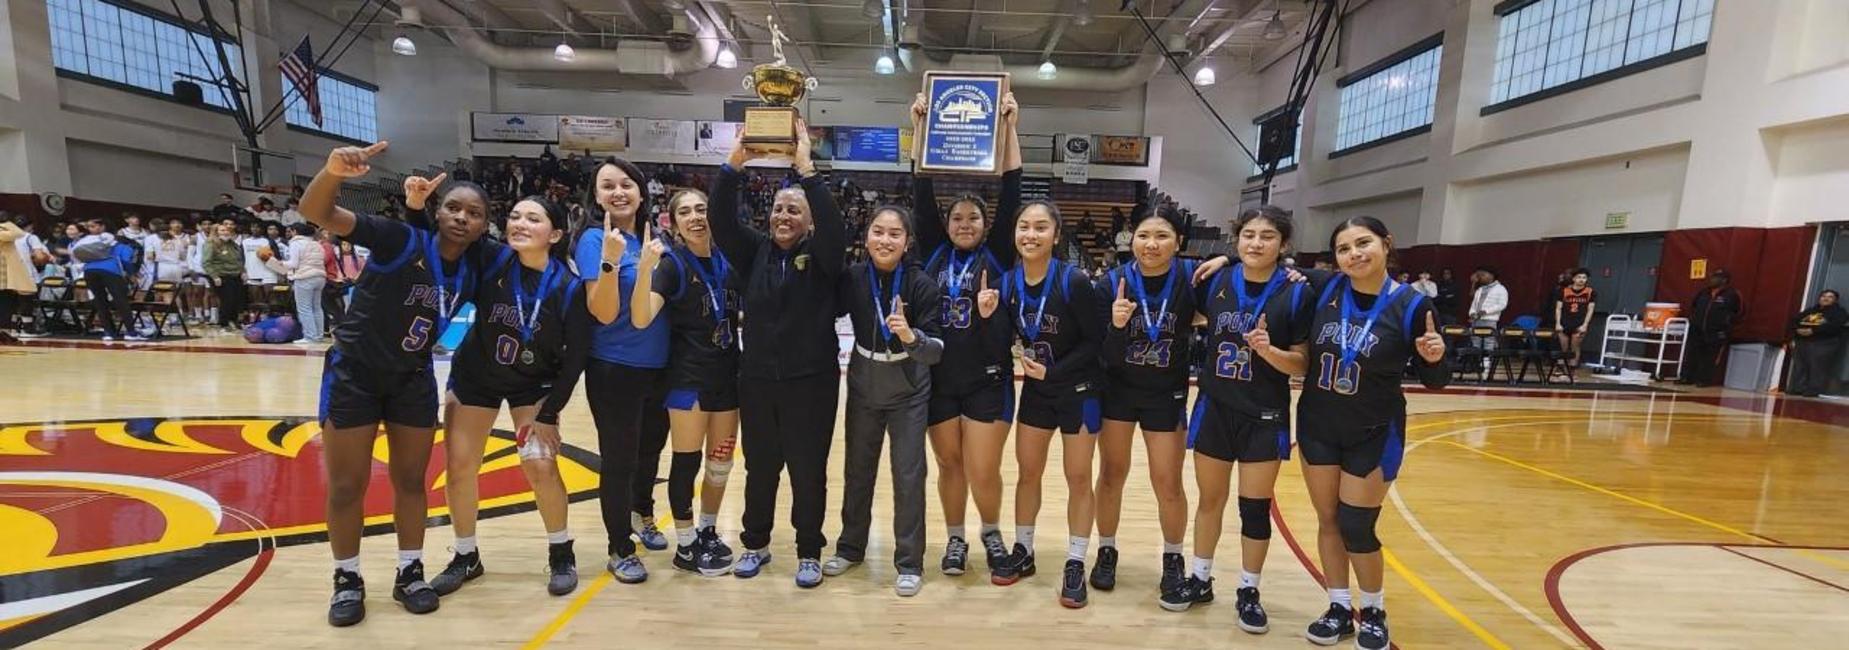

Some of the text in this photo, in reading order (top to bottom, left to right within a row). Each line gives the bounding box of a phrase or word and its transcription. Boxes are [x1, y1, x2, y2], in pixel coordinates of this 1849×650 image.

[401, 315, 434, 352] 5
[496, 333, 520, 365] 0
[1318, 351, 1361, 395] 10
